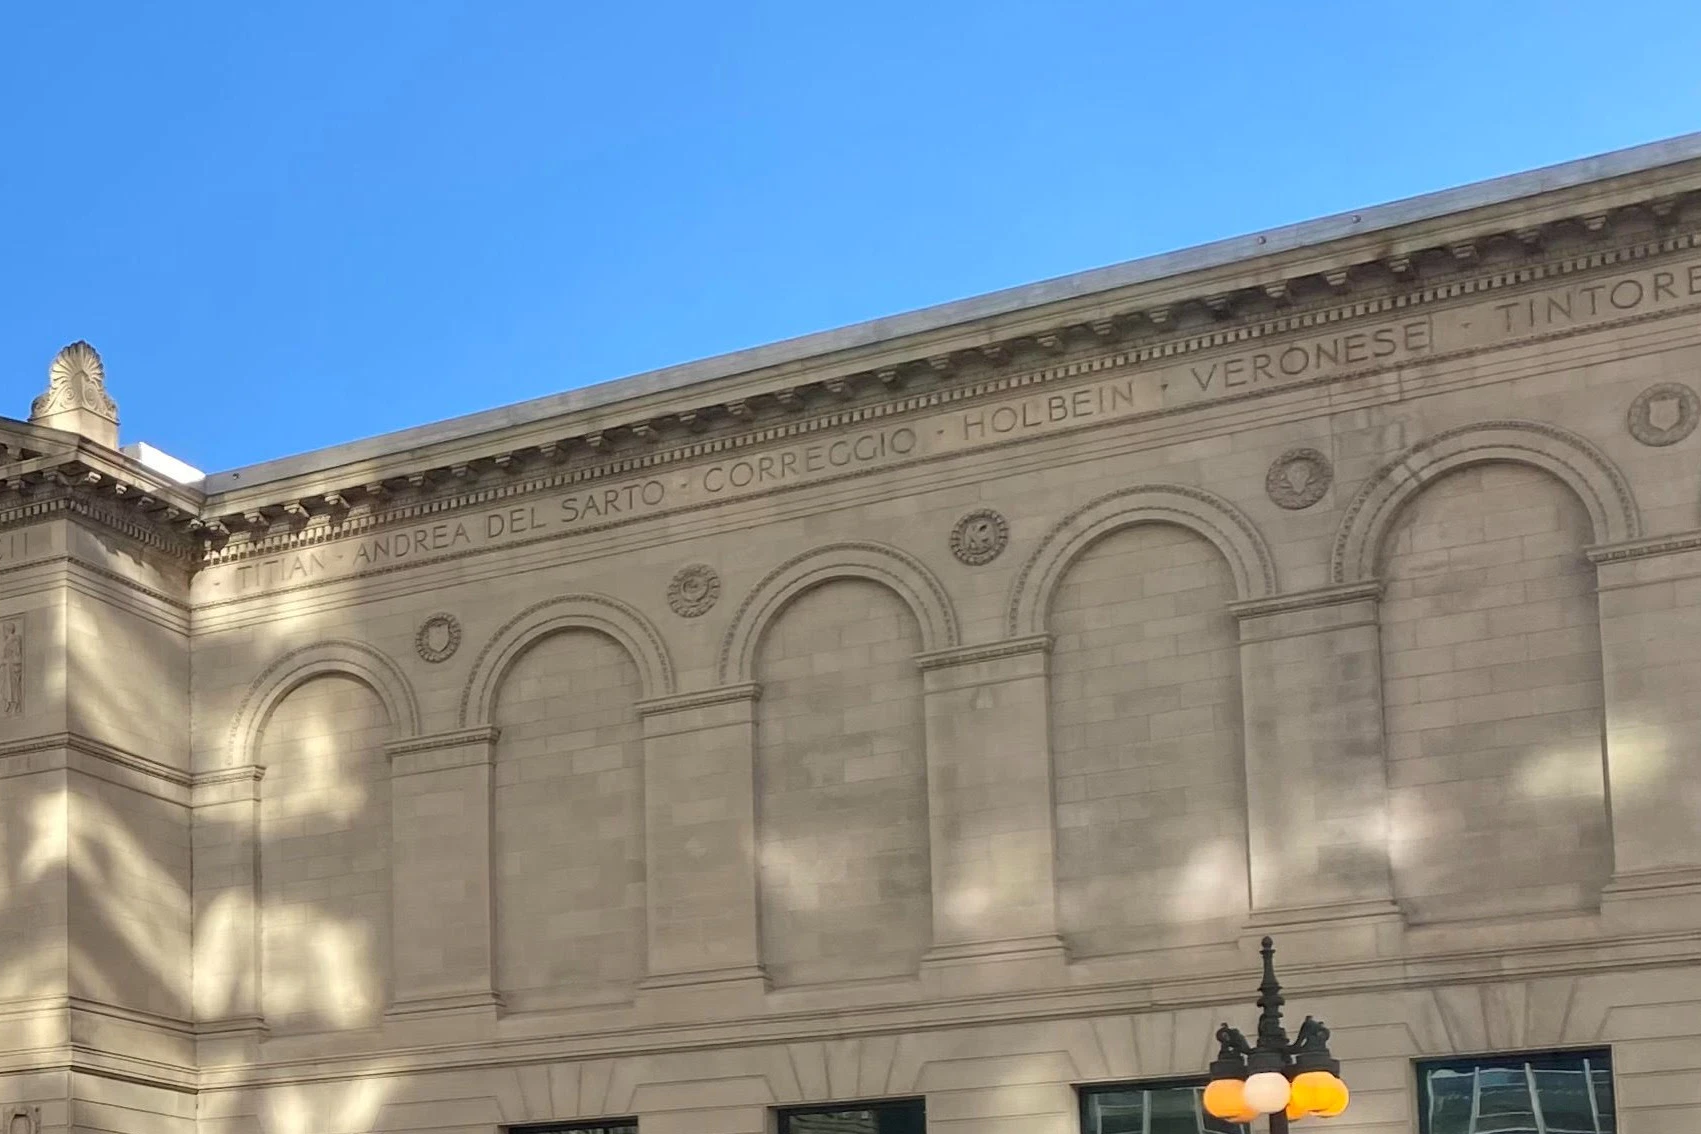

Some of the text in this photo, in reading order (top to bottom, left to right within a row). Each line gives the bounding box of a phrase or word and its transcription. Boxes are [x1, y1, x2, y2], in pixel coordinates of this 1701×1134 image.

[237, 265, 1701, 590] TITIAN ANDREA DEL SARTO CORREGGIO HOLBEIN VERONESE TINTORE
